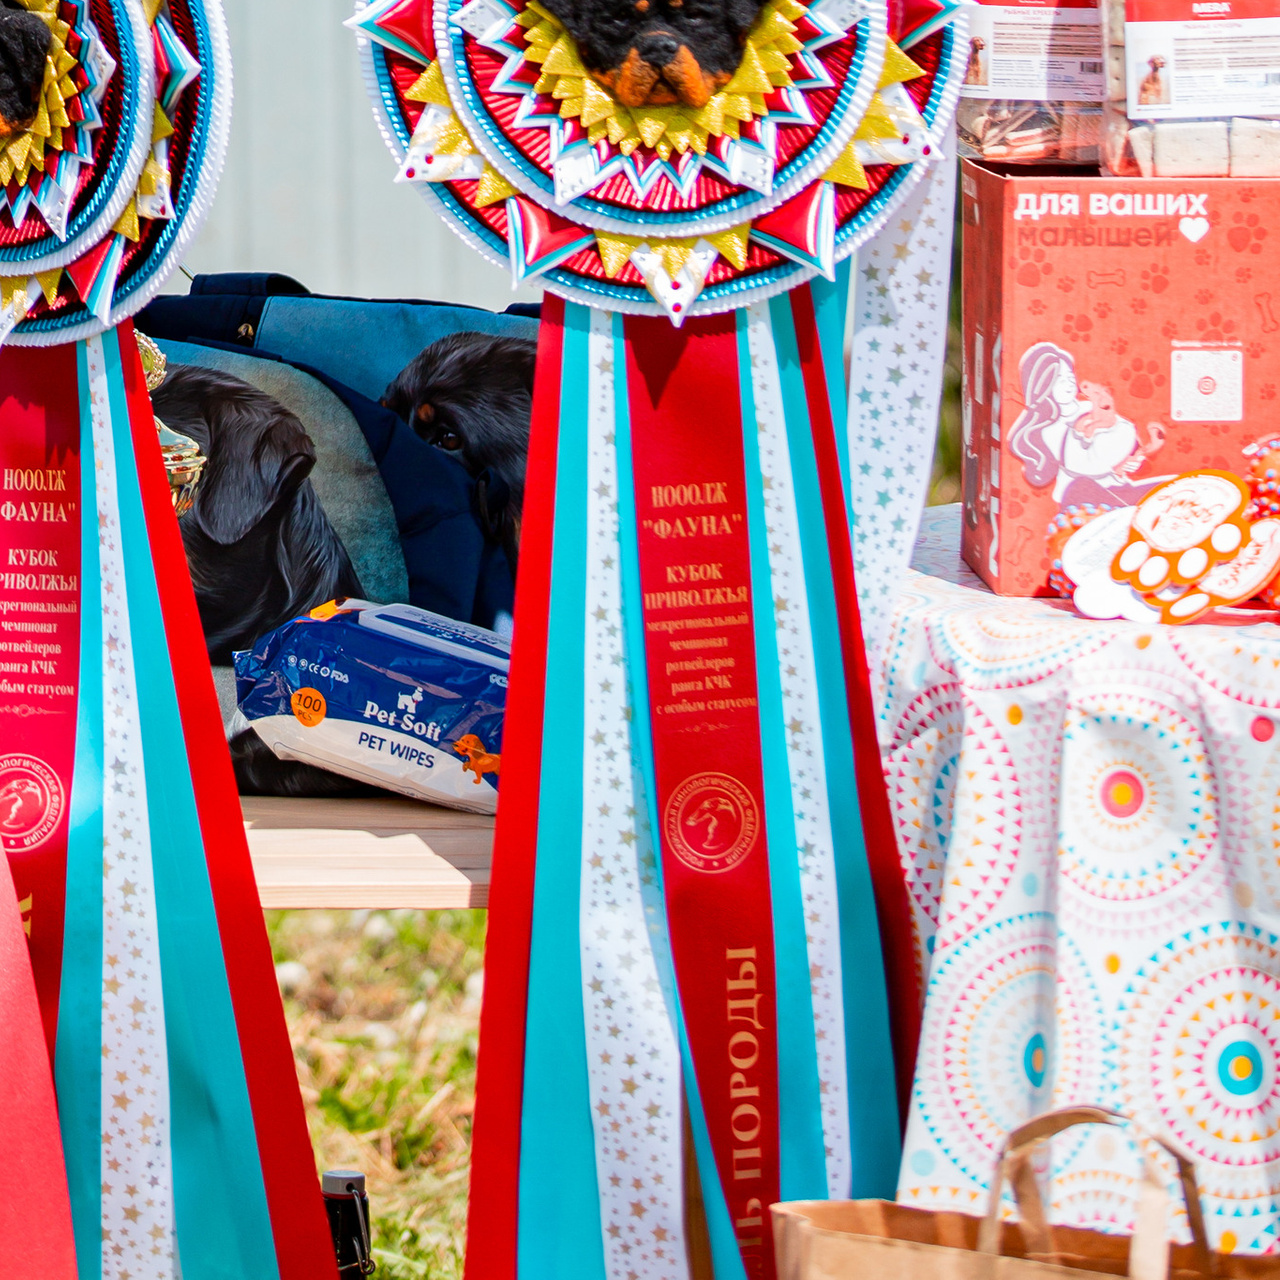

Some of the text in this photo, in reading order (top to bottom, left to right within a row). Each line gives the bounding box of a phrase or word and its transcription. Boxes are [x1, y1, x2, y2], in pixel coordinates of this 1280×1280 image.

[1013, 193, 1208, 220] для ваших
[1017, 222, 1173, 247] малышей
[3, 468, 66, 491] НОООЛЖ
[651, 482, 728, 508] НОООЛЖ
[643, 514, 742, 539] "ФАУНА"
[8, 548, 58, 567] КУБОК
[666, 563, 723, 584] КУБОК
[644, 586, 748, 610] ПРИВОЛЖЬЯ
[1, 621, 58, 633] чемпионат
[646, 612, 749, 634] межрегиональный
[669, 637, 728, 651] чемпионат
[31, 660, 57, 675] КЧК
[331, 670, 349, 683] FDA
[666, 656, 735, 676] ротвейлеров
[27, 684, 74, 699] статусом
[705, 674, 732, 689] КЧК
[296, 693, 322, 712] 100
[298, 709, 312, 722] PCS
[363, 700, 441, 742] Pet Soft
[358, 732, 435, 769] PET WIPES
[23, 795, 60, 846] ФЕДЕРАЦИЯ
[726, 946, 766, 1180] ПОРОДЫ
